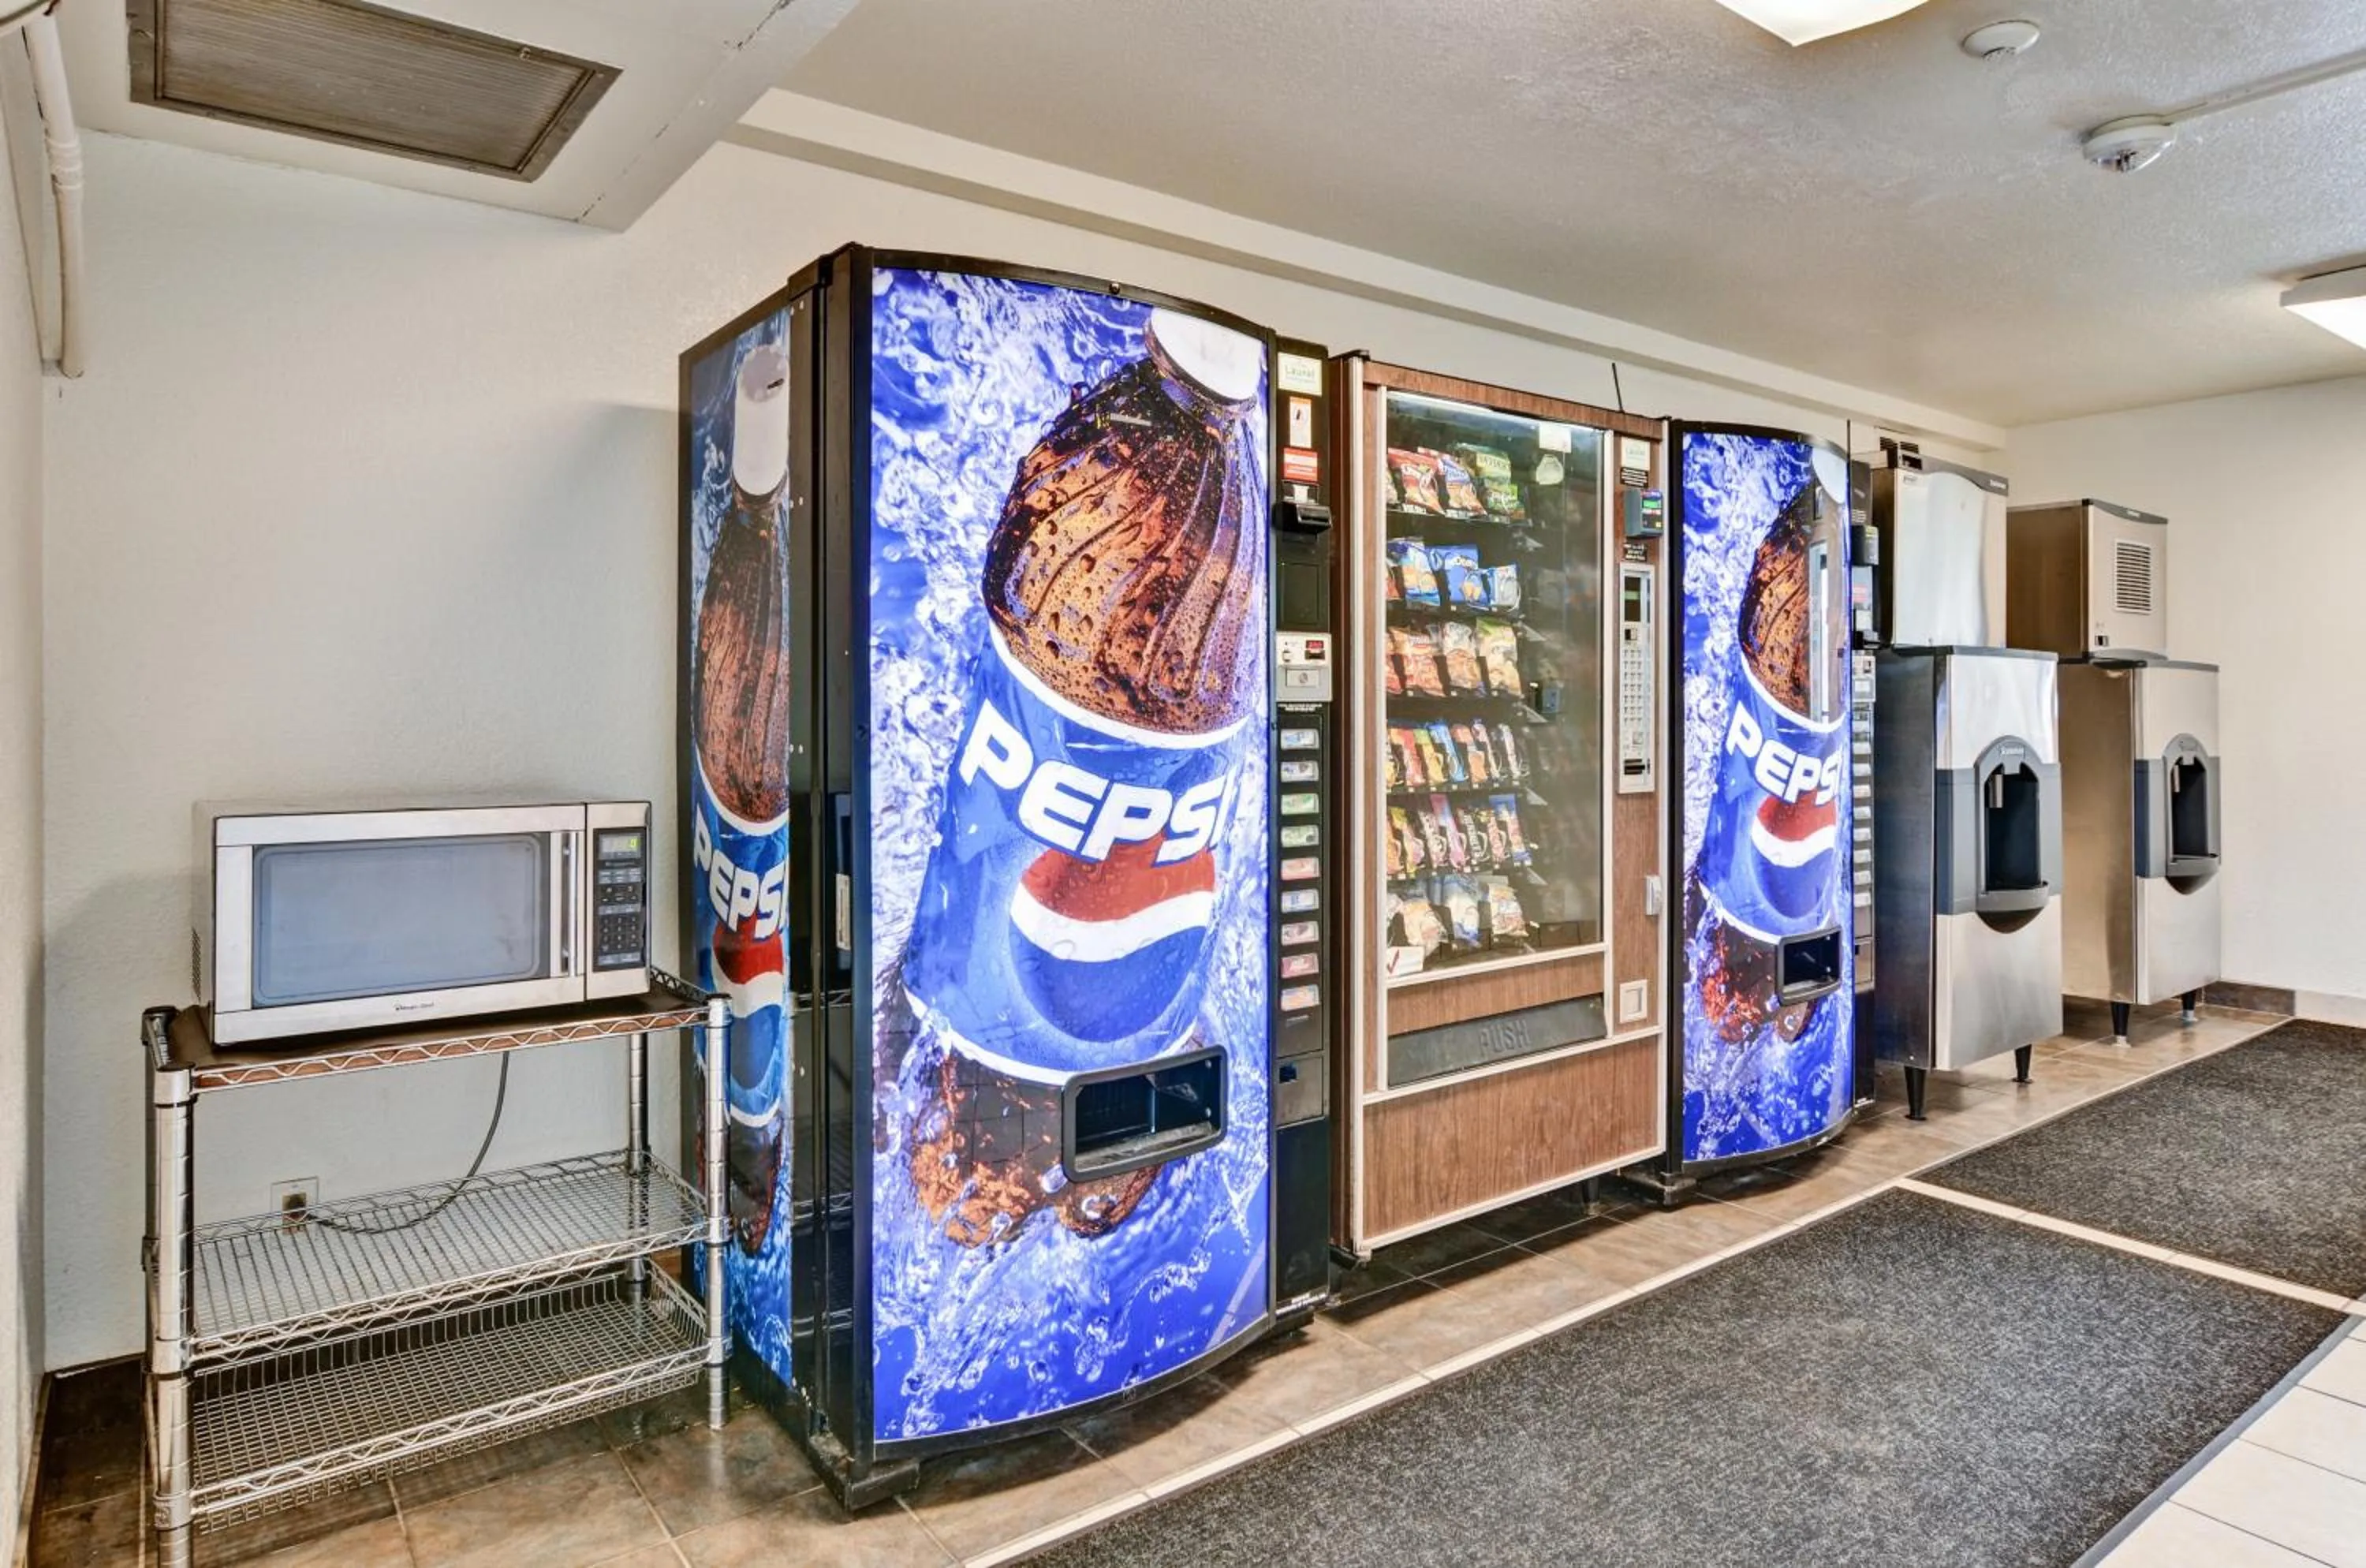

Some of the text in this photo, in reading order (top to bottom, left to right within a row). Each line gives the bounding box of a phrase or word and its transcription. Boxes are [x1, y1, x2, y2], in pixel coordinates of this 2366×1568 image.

[957, 698, 1237, 864] PEPSI
[693, 802, 789, 939] PEPSI
[1479, 1018, 1532, 1060] PUSH
